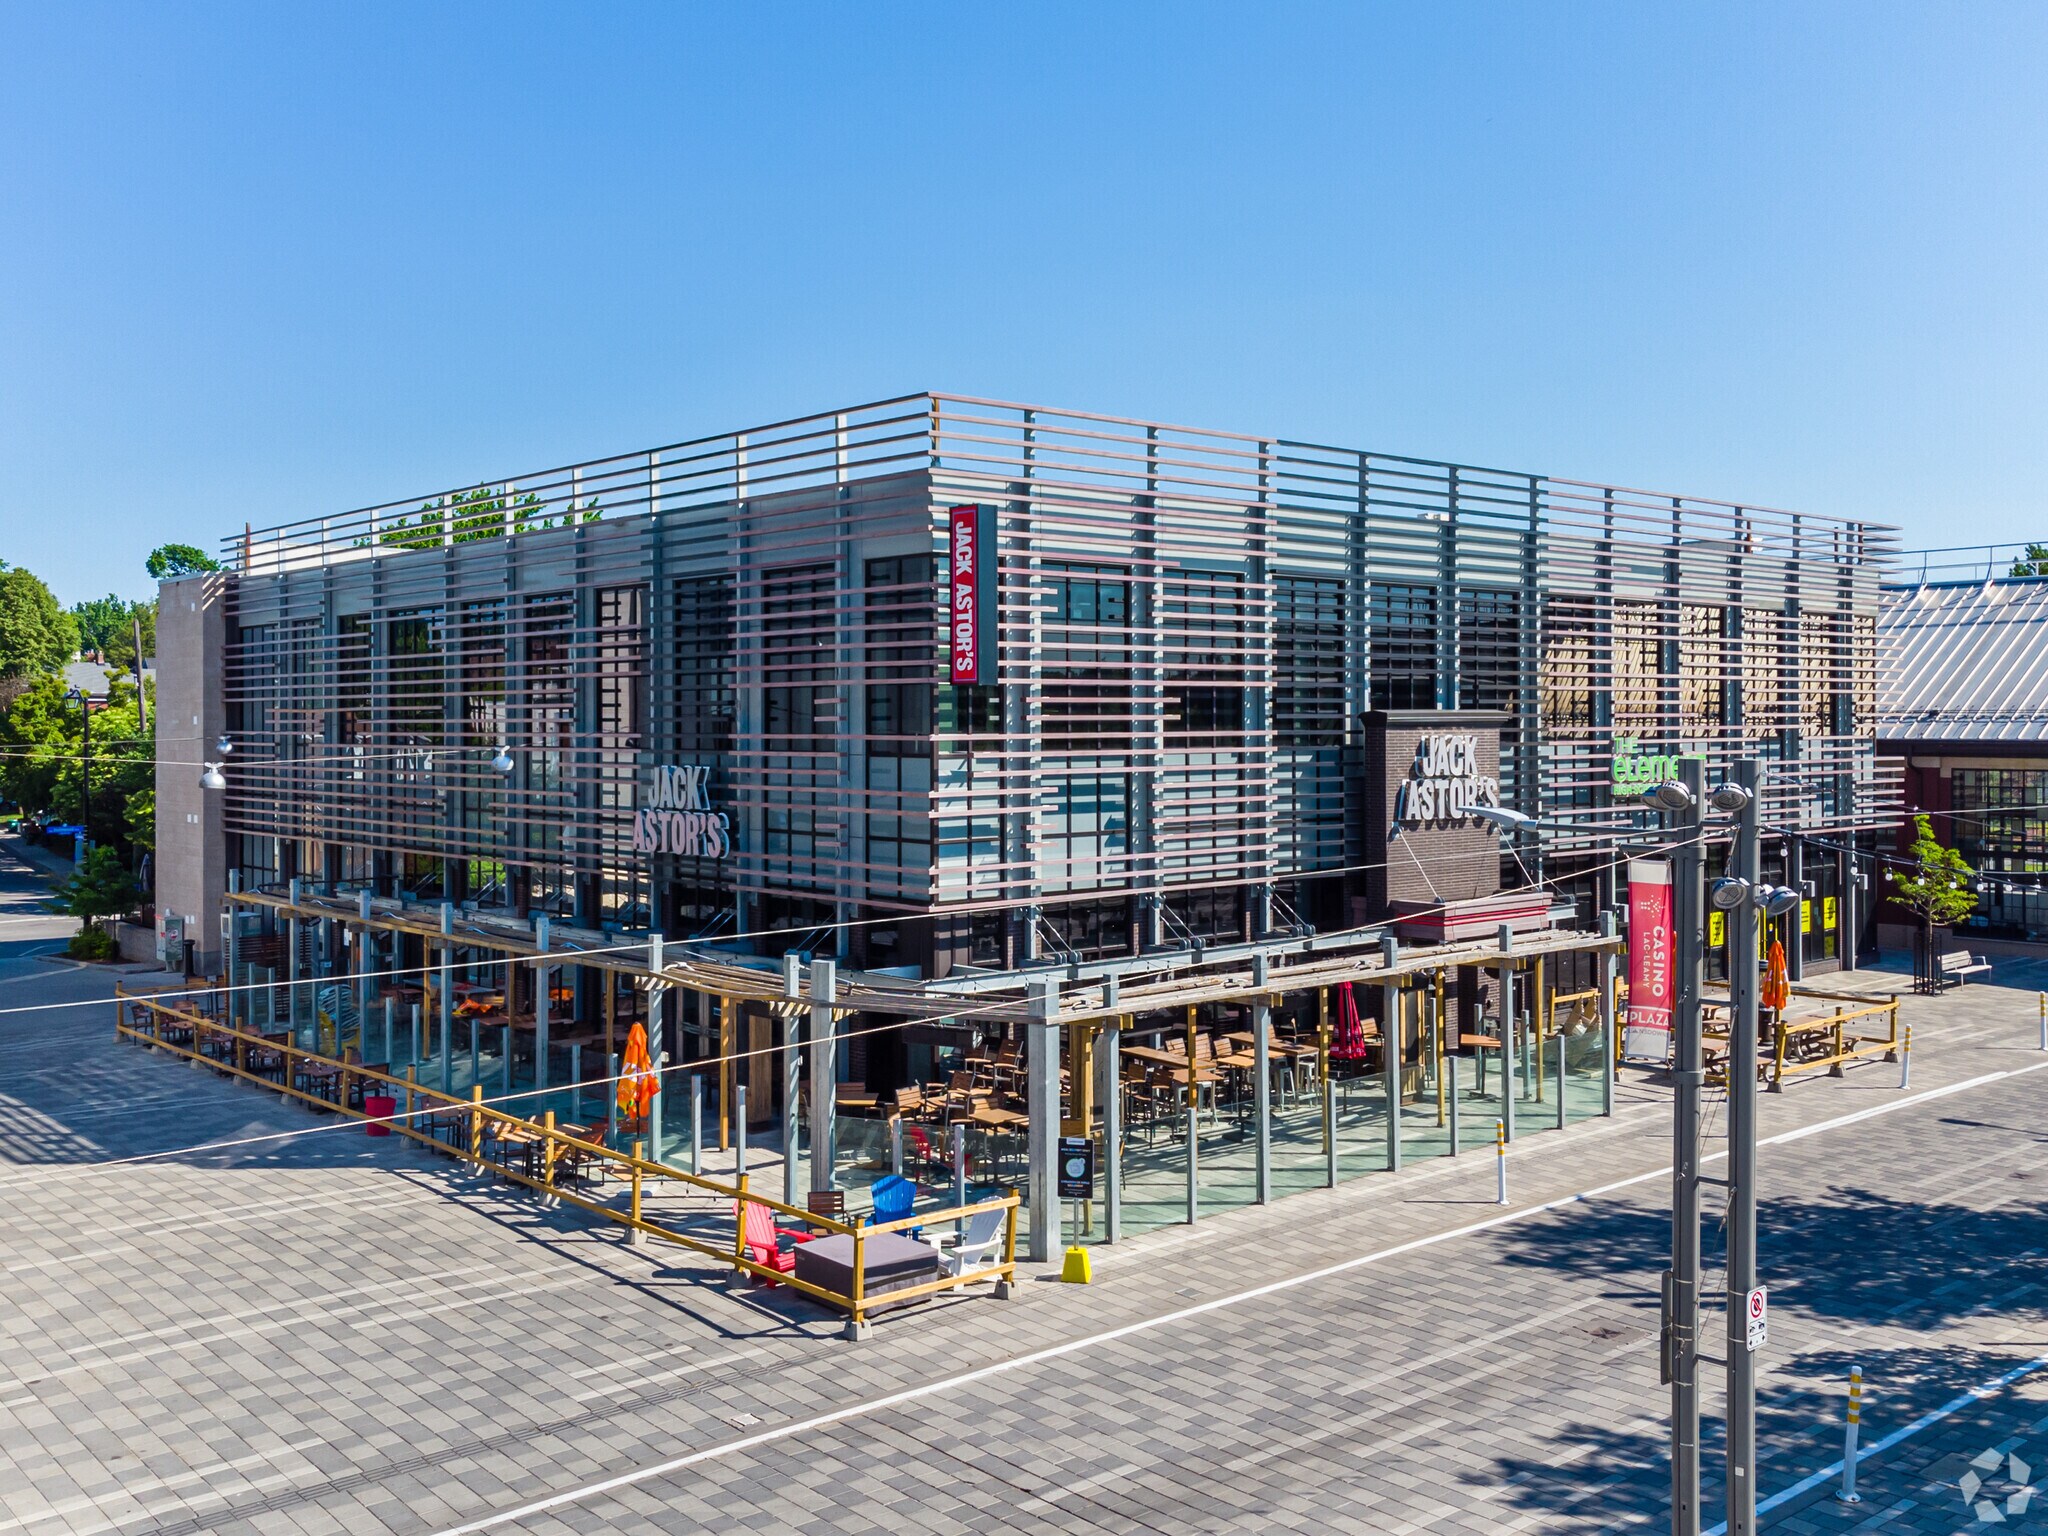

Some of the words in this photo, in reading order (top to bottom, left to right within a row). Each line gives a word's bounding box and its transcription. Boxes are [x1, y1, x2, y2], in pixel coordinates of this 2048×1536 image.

[955, 522, 973, 576] JACK
[955, 584, 973, 671] ASTOR'S
[1420, 735, 1478, 777] JACK
[1613, 737, 1638, 754] THE
[648, 765, 708, 810] JACK
[1404, 778, 1498, 820] ASTOR'S
[633, 811, 725, 859] ASTOR'S
[1652, 926, 1665, 997] CASINO
[1630, 1011, 1669, 1026] PLAZA
